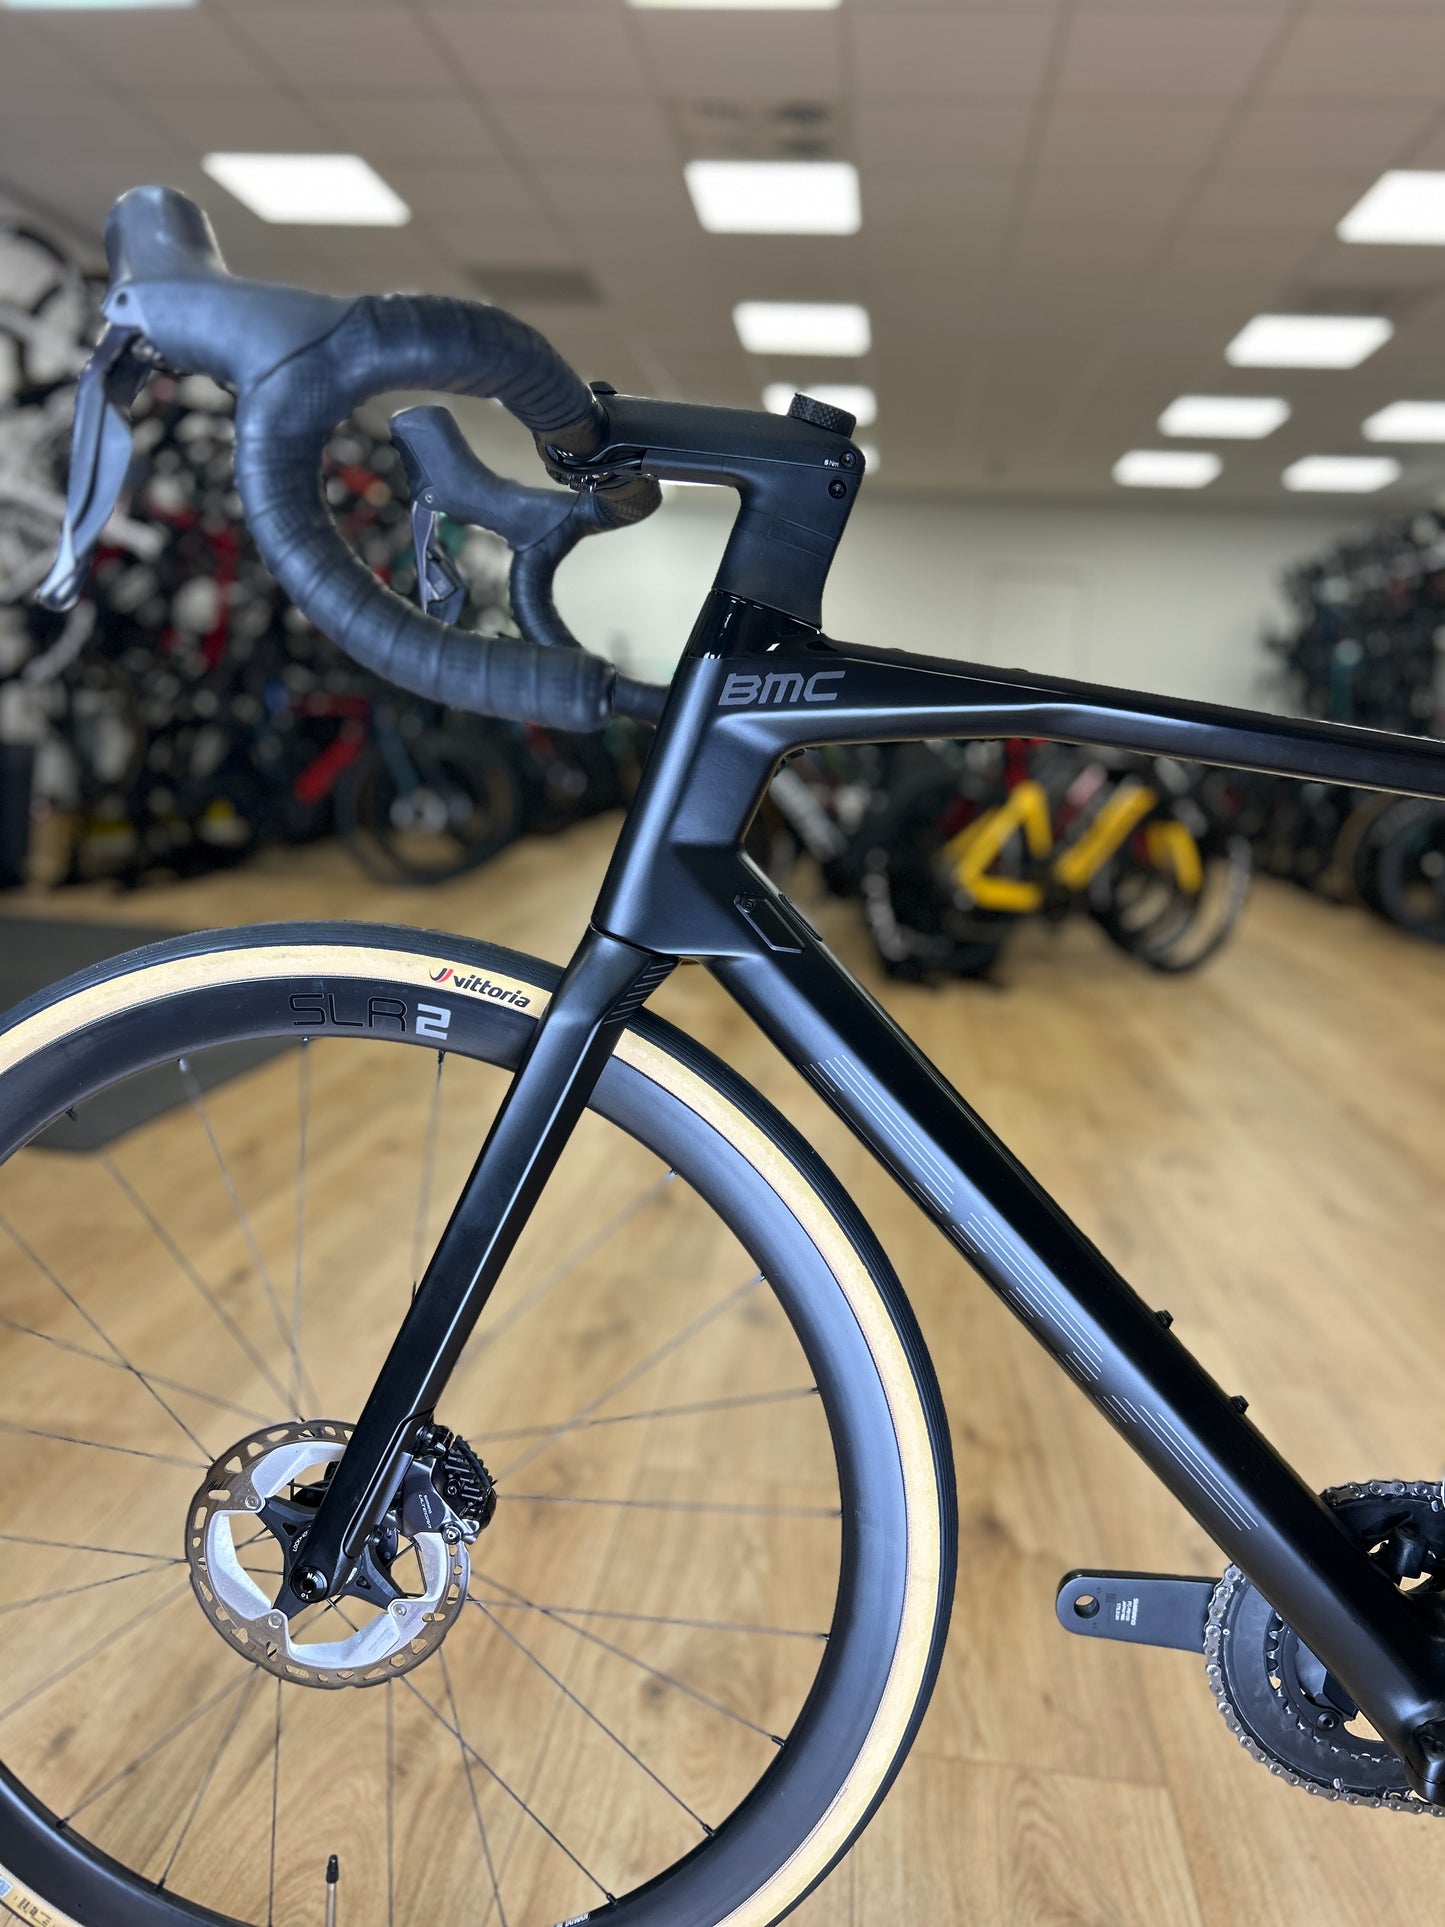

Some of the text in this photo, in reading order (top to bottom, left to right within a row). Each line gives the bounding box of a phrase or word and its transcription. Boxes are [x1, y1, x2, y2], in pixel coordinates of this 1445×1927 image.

[718, 671, 846, 706] BMC
[452, 974, 532, 1009] vittoria
[289, 993, 451, 1041] SLR 2
